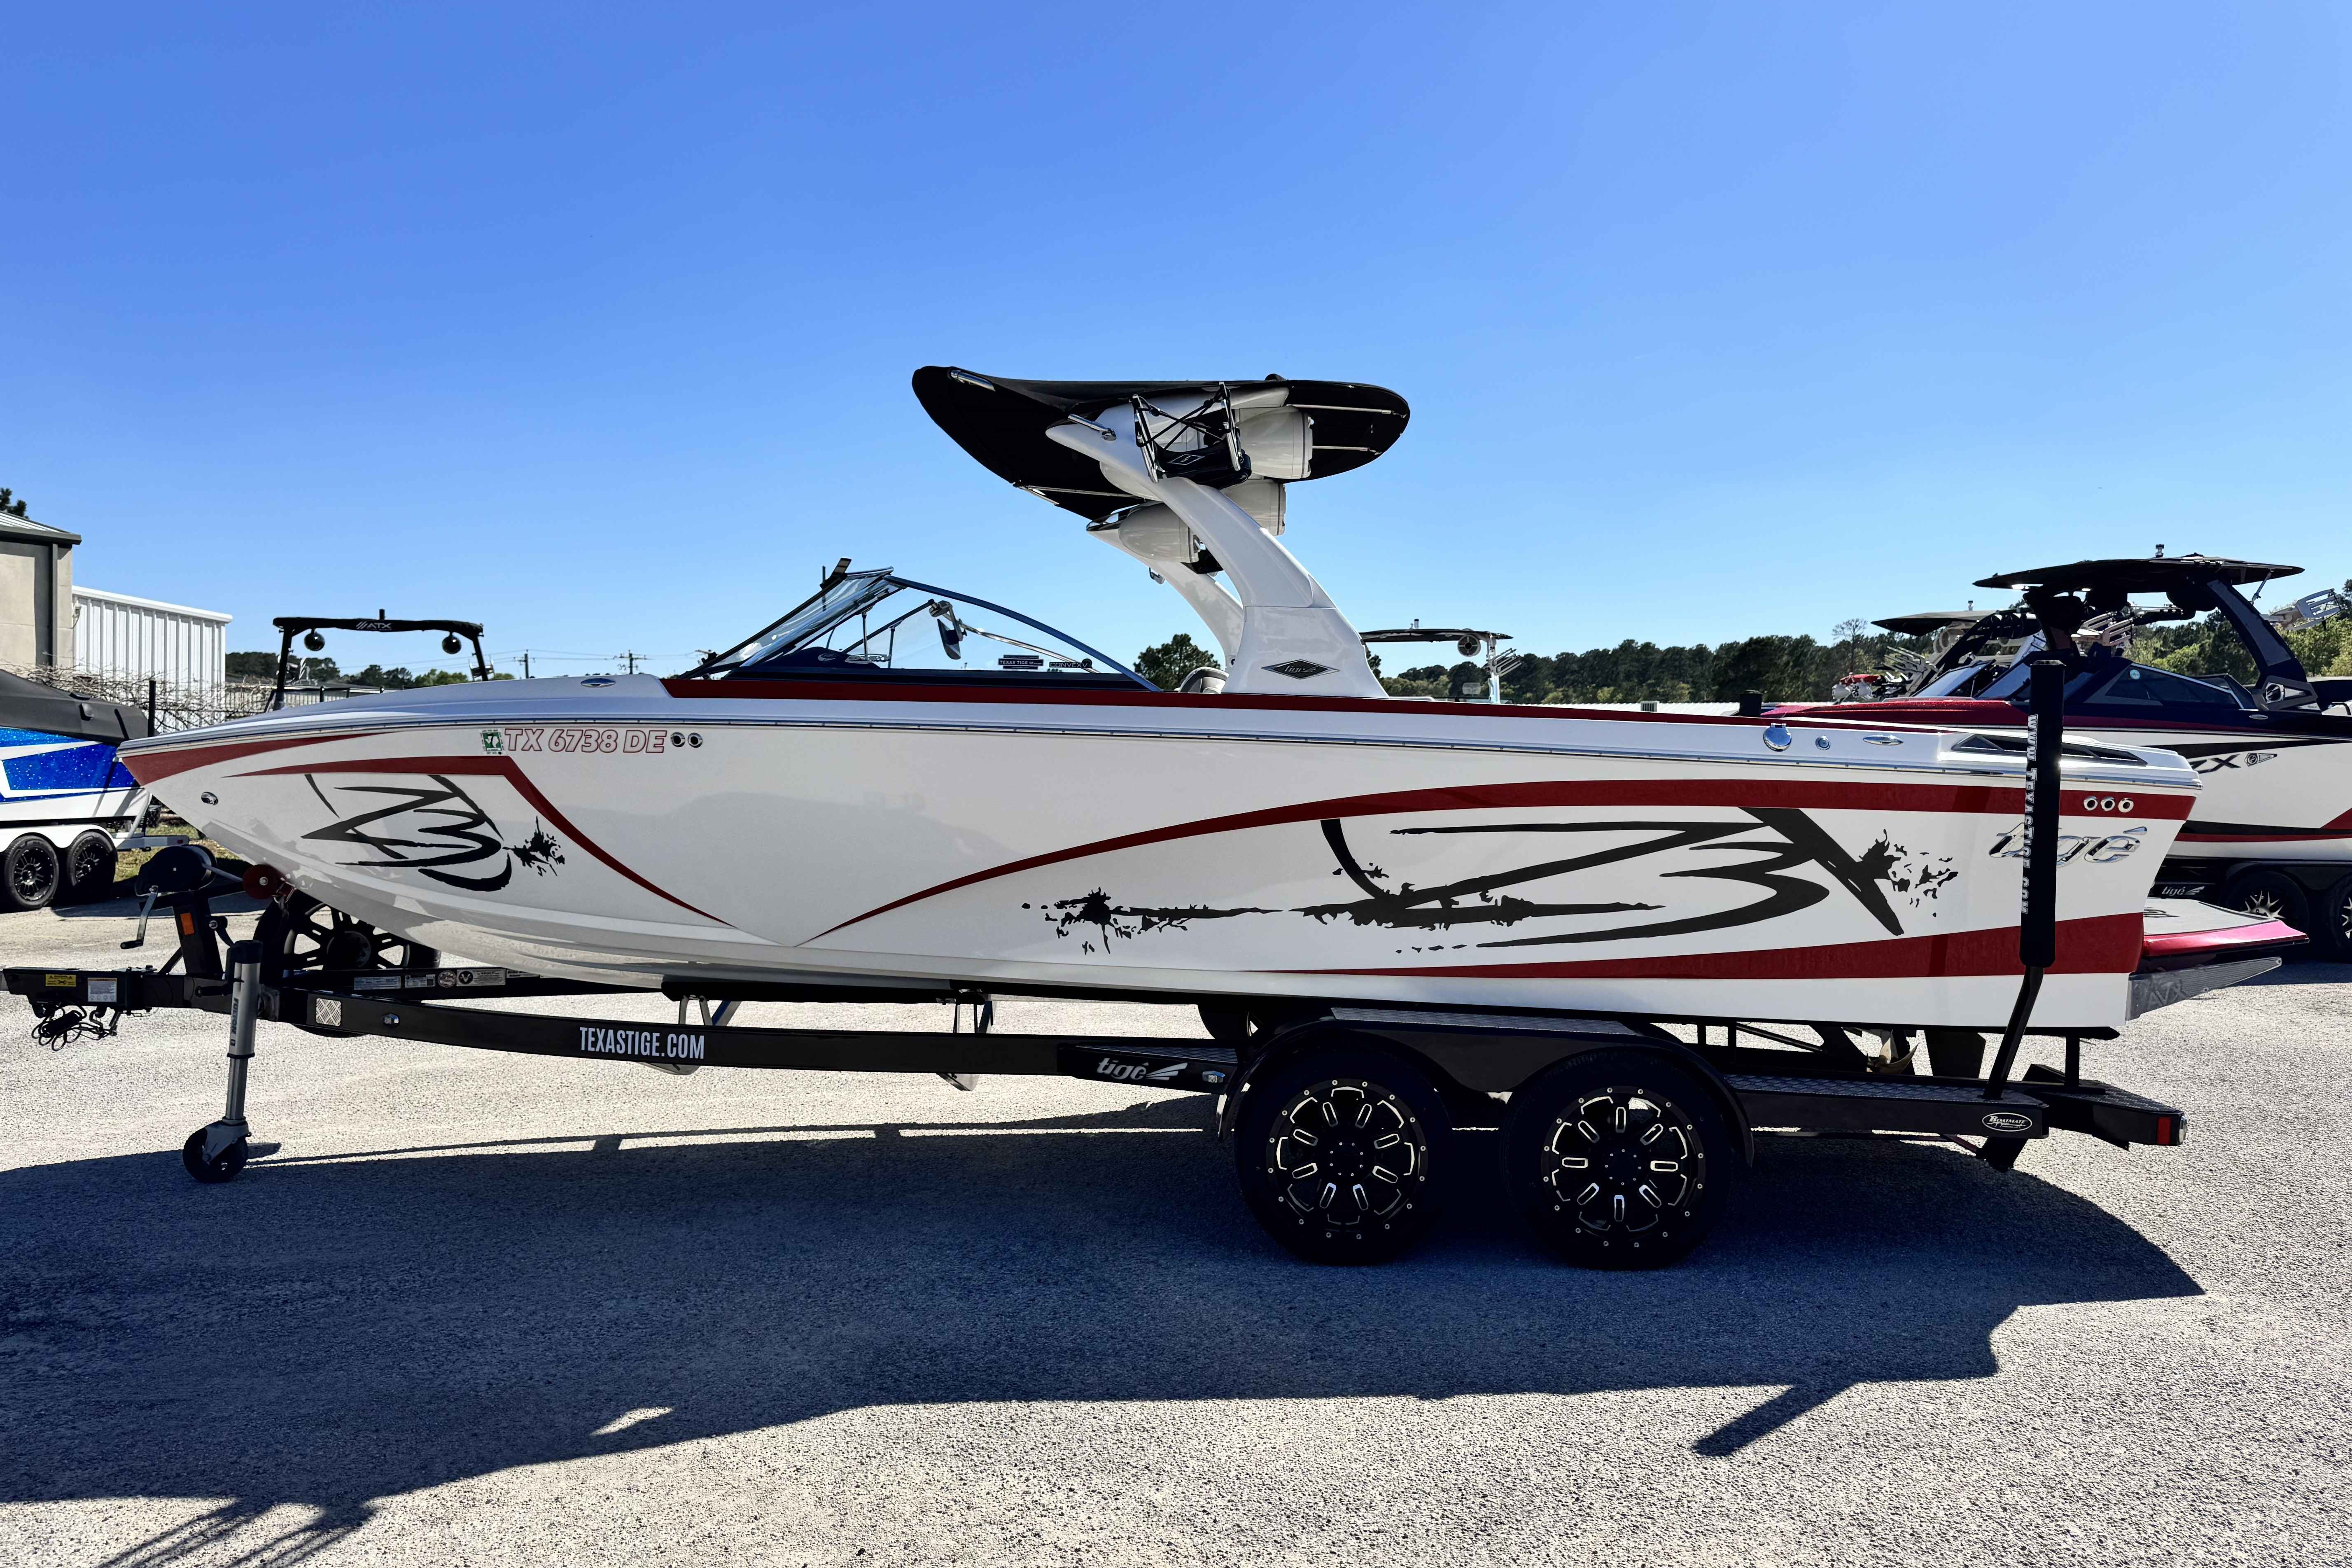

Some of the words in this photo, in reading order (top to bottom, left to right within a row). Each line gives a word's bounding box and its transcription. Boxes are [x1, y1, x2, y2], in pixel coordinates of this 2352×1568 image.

[504, 728, 545, 752] TX
[548, 729, 619, 753] 6738
[623, 729, 667, 754] DE
[1988, 822, 2148, 869] tgé
[579, 1027, 705, 1059] TEXASTIGE.COM
